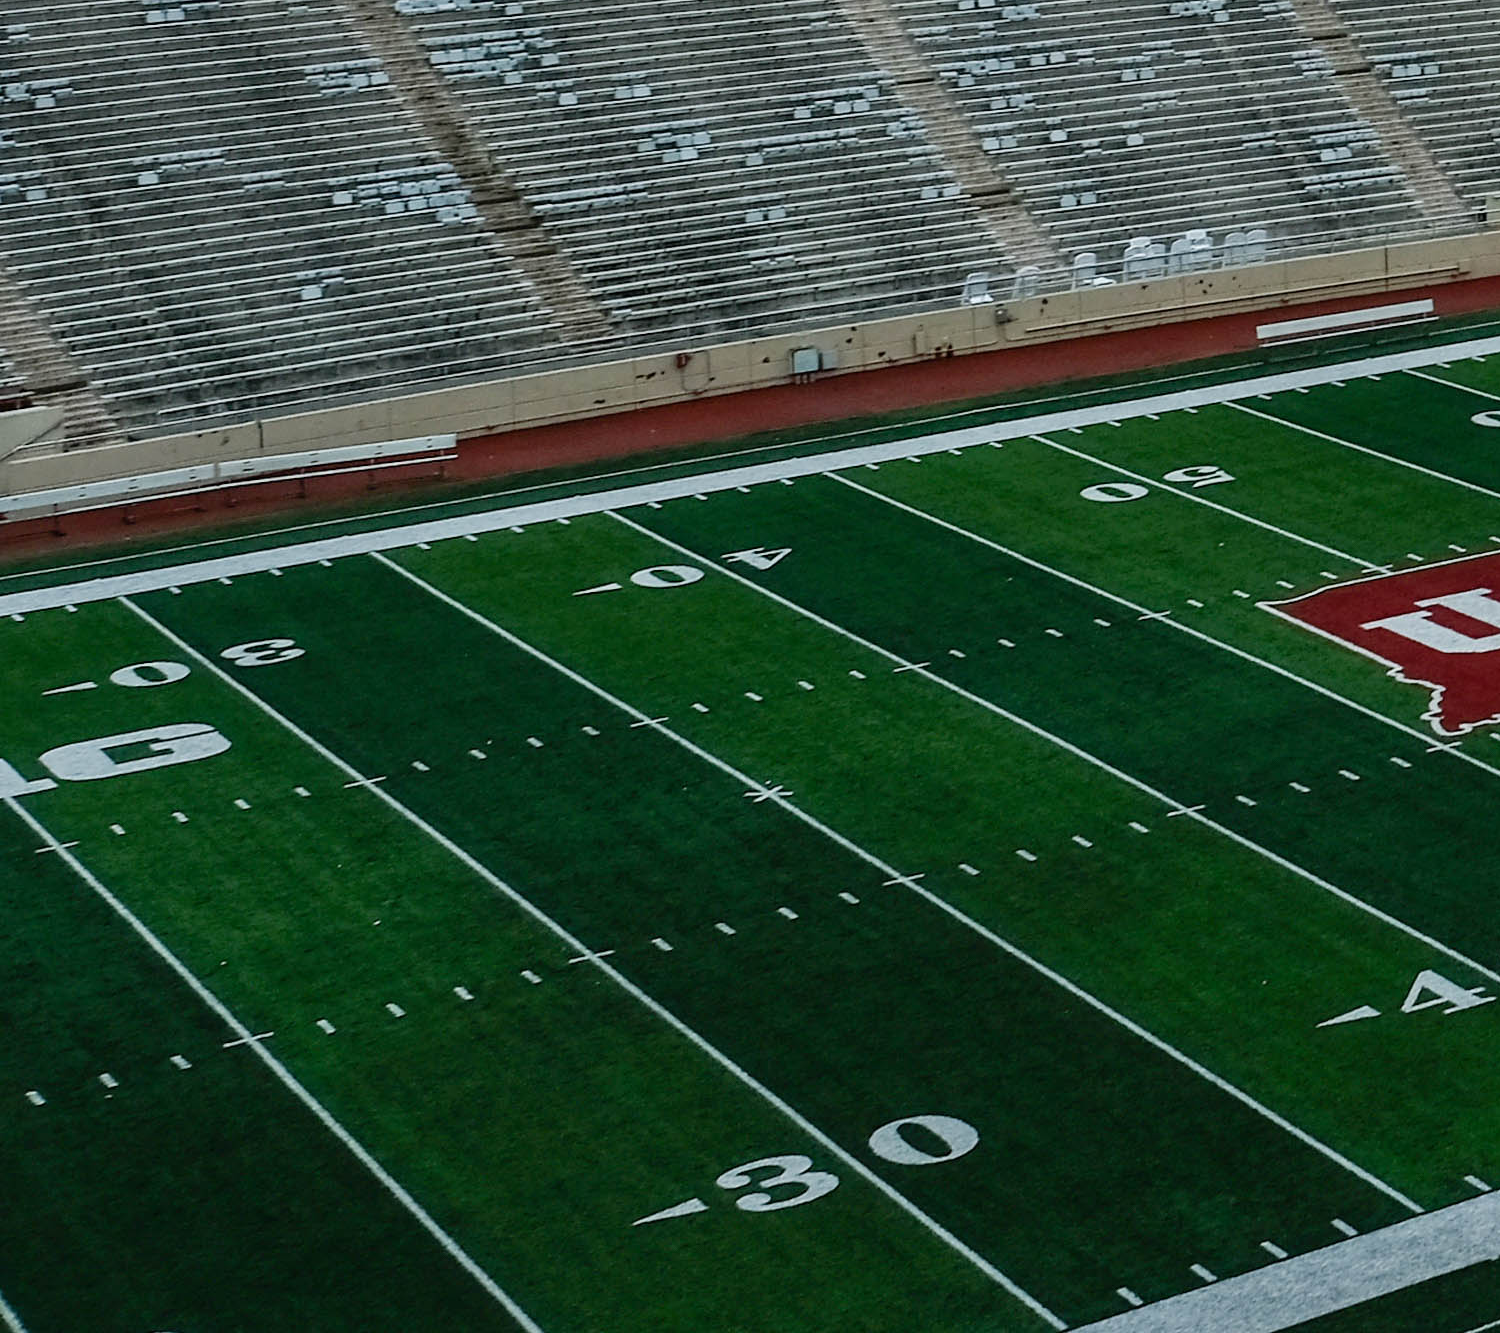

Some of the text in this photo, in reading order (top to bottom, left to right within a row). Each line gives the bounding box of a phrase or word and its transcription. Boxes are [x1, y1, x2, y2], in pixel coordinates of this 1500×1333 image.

[1079, 464, 1236, 503] 50
[629, 546, 794, 589] 40
[109, 636, 307, 688] 30
[715, 1114, 980, 1213] 30
